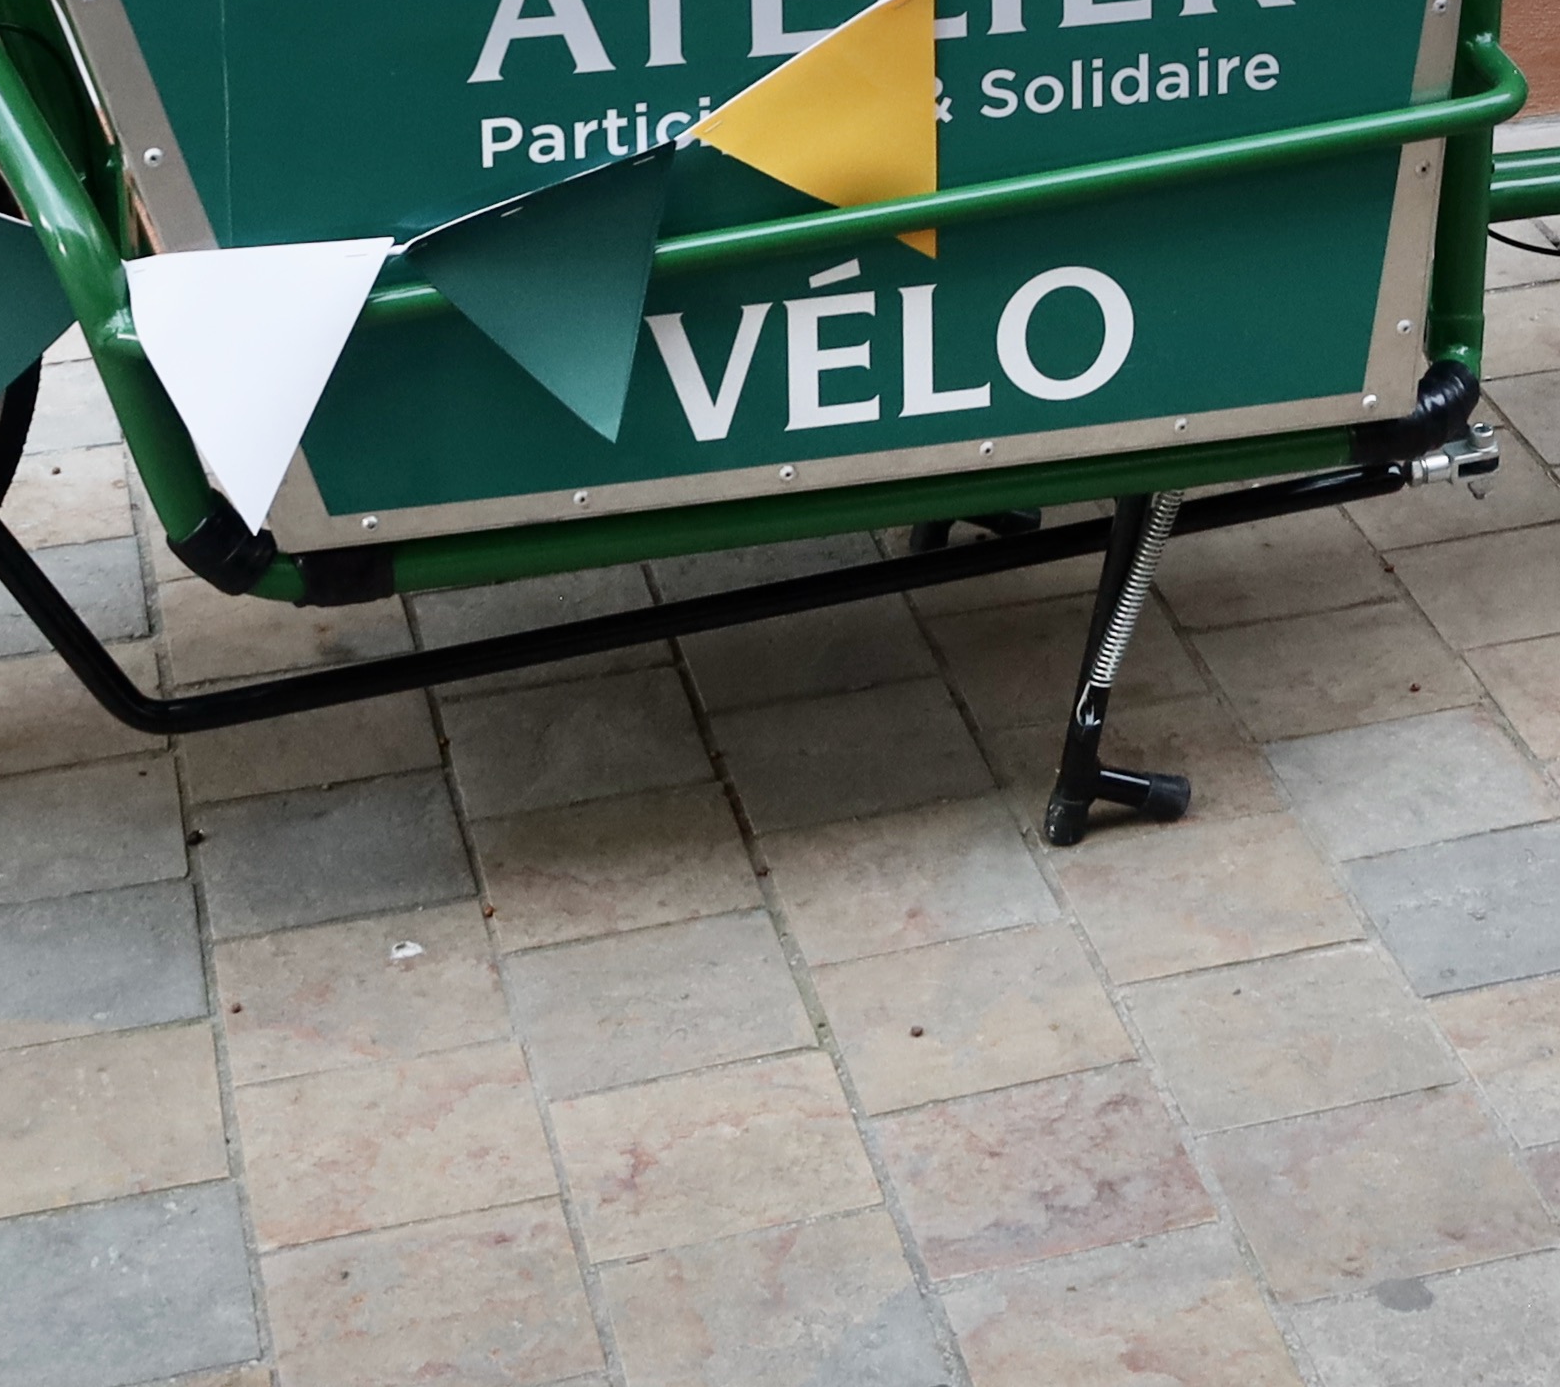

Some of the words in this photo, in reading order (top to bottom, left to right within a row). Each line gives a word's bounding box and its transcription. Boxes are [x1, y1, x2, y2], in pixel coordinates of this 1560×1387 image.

[480, 98, 712, 169] Partici
[978, 45, 1281, 120] Solidaire
[645, 259, 1135, 442] VÉLO
